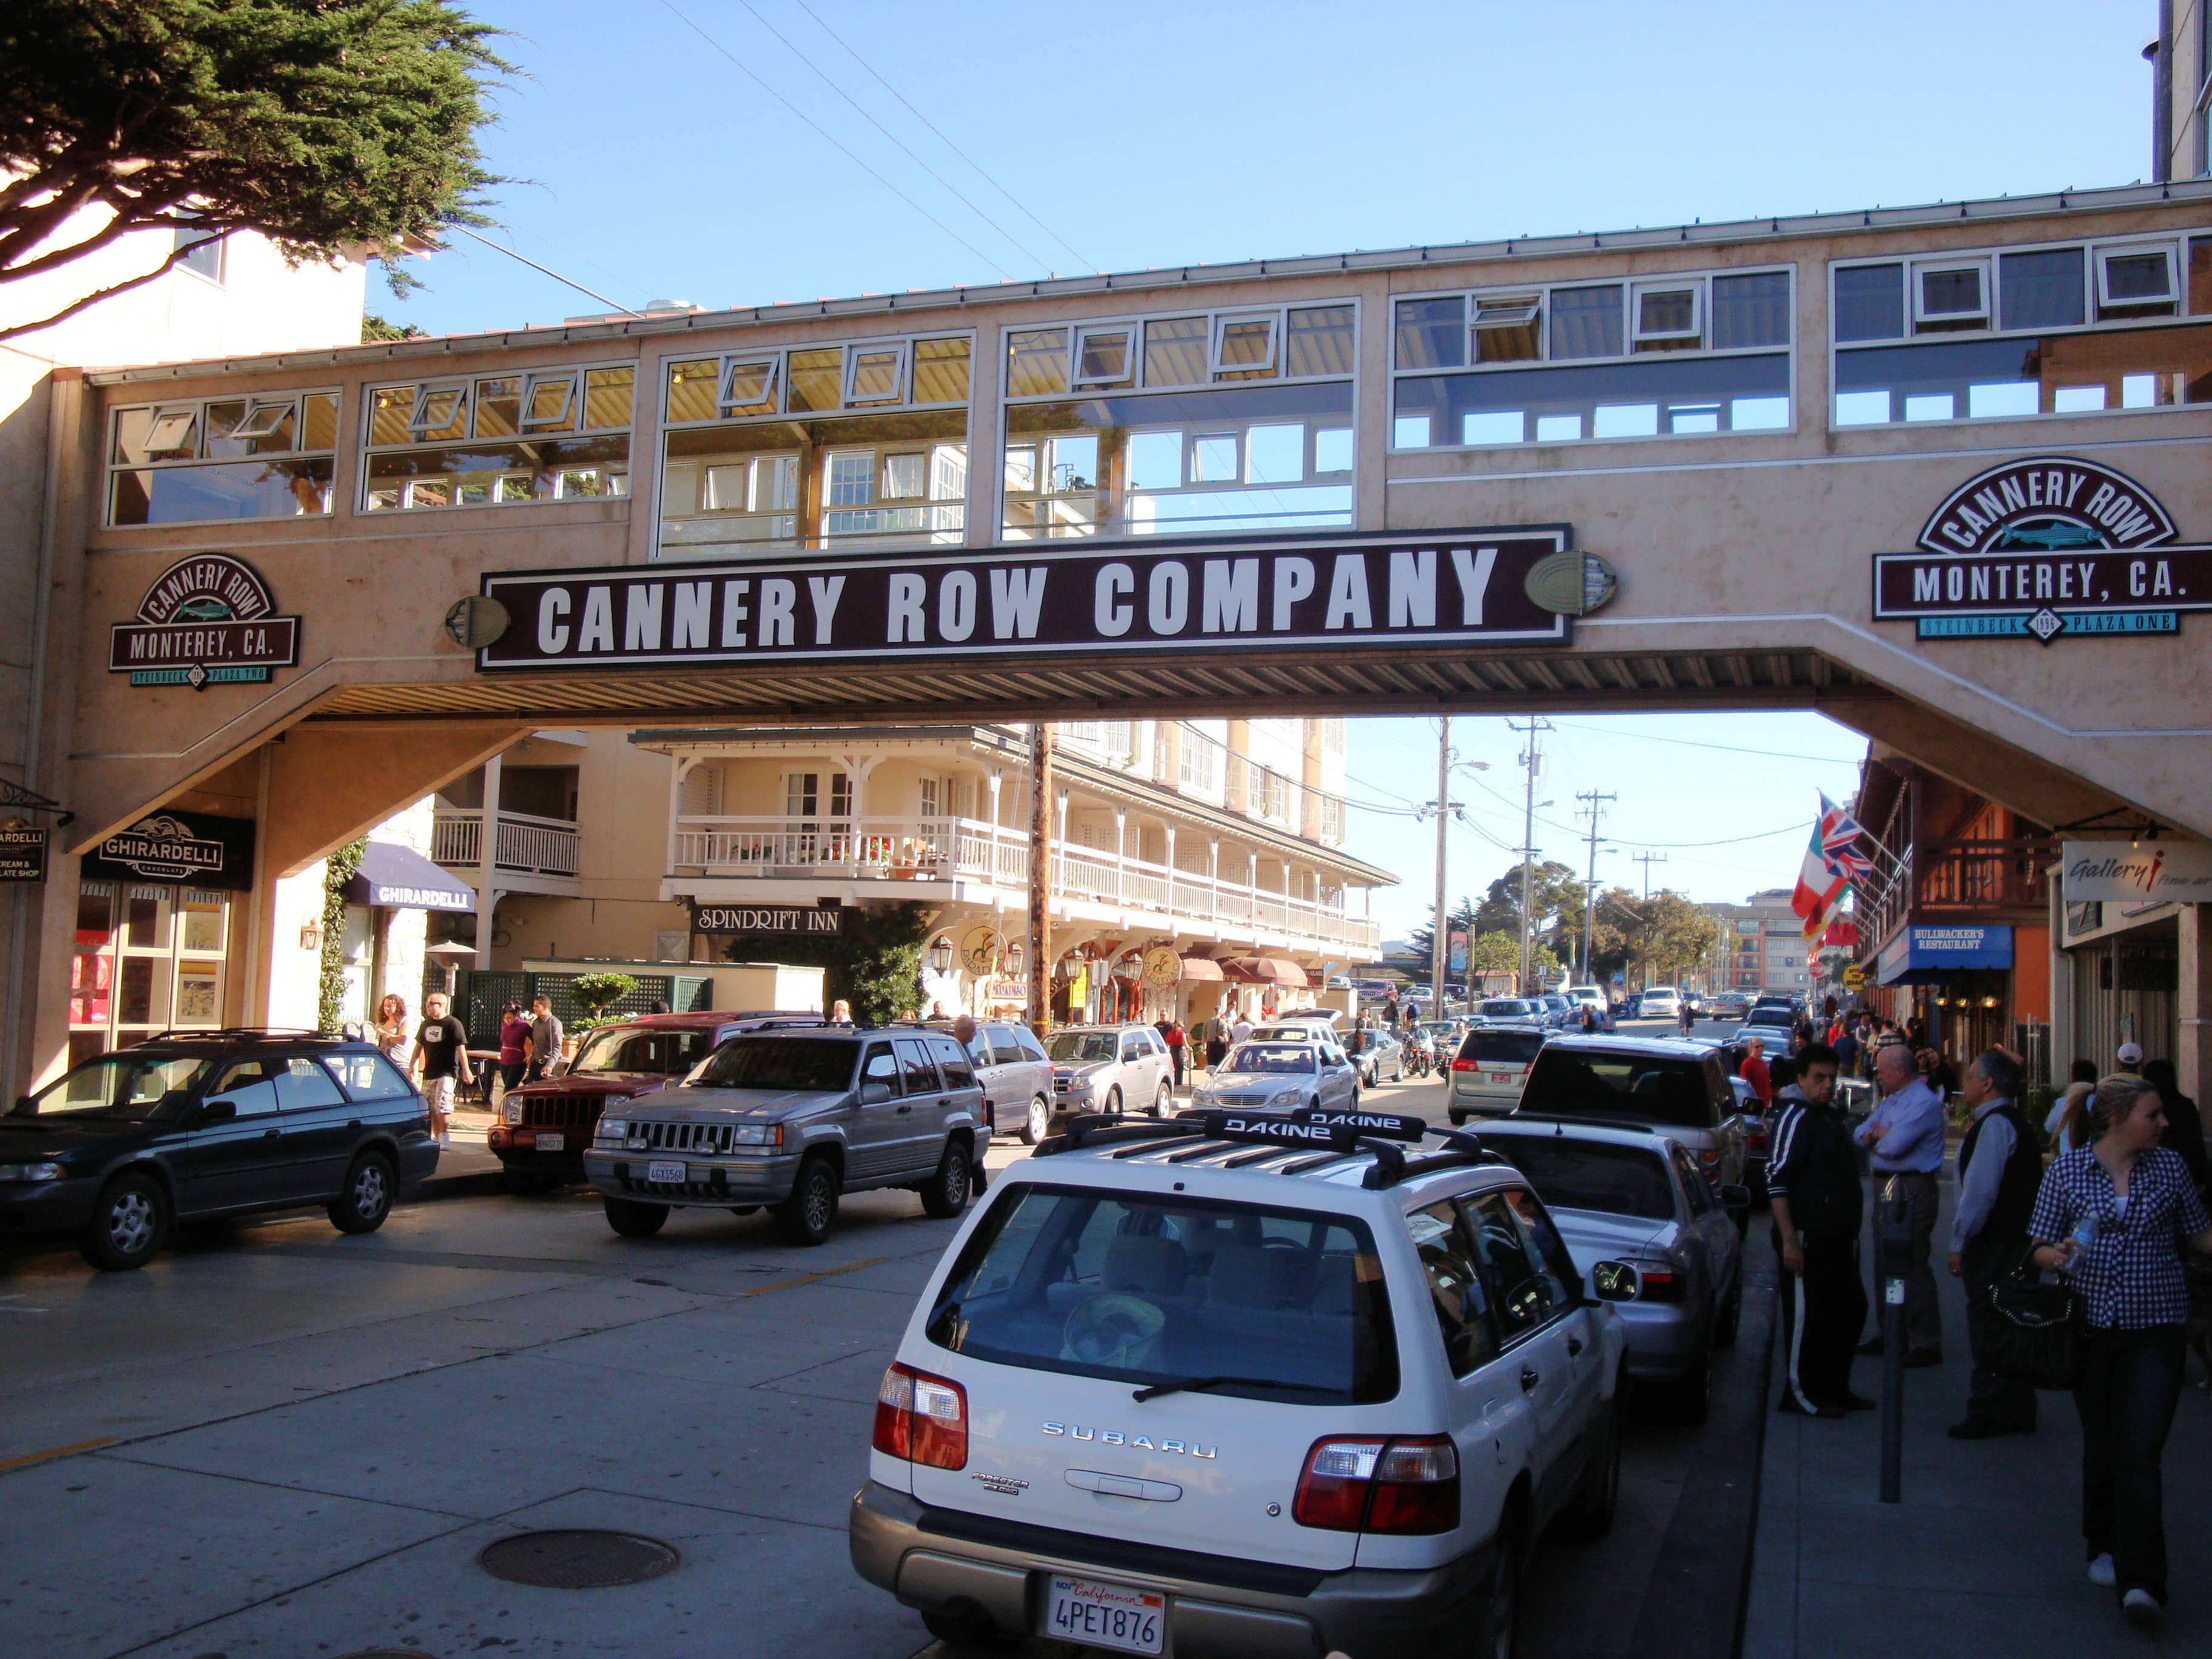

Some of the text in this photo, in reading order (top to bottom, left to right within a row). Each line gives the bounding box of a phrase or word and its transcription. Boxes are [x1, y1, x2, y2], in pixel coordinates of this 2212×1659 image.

[1942, 472, 2156, 548] CANNERY ROW
[149, 564, 261, 619] CANNERY ROW
[1914, 560, 2186, 602] MONTEREY, CA.
[538, 548, 1498, 654] CANNERY ROW COMPANY
[1925, 614, 2170, 634] STEINBECK PLAZA ONE
[2036, 617, 2054, 631] 1996
[131, 629, 273, 659] MONTEREY, CA.
[134, 668, 264, 683] STEINBECK PLAZA TWO
[106, 838, 217, 863] GHIRARDELLI
[2070, 858, 2148, 887] Gallery
[380, 886, 468, 908] GHIRARDELLI
[699, 909, 839, 931] SPINDRIFT INN
[1914, 929, 1985, 939] BULLWACKER'S
[1919, 940, 1980, 949] RESTAURANT
[1223, 1119, 1332, 1140] DAKINE
[1042, 1420, 1218, 1460] SUBARU
[971, 1472, 1029, 1489] FORESTER
[1056, 1581, 1071, 1590] NOV
[1074, 1583, 1143, 1606] California
[1056, 1598, 1156, 1643] 4PET876
